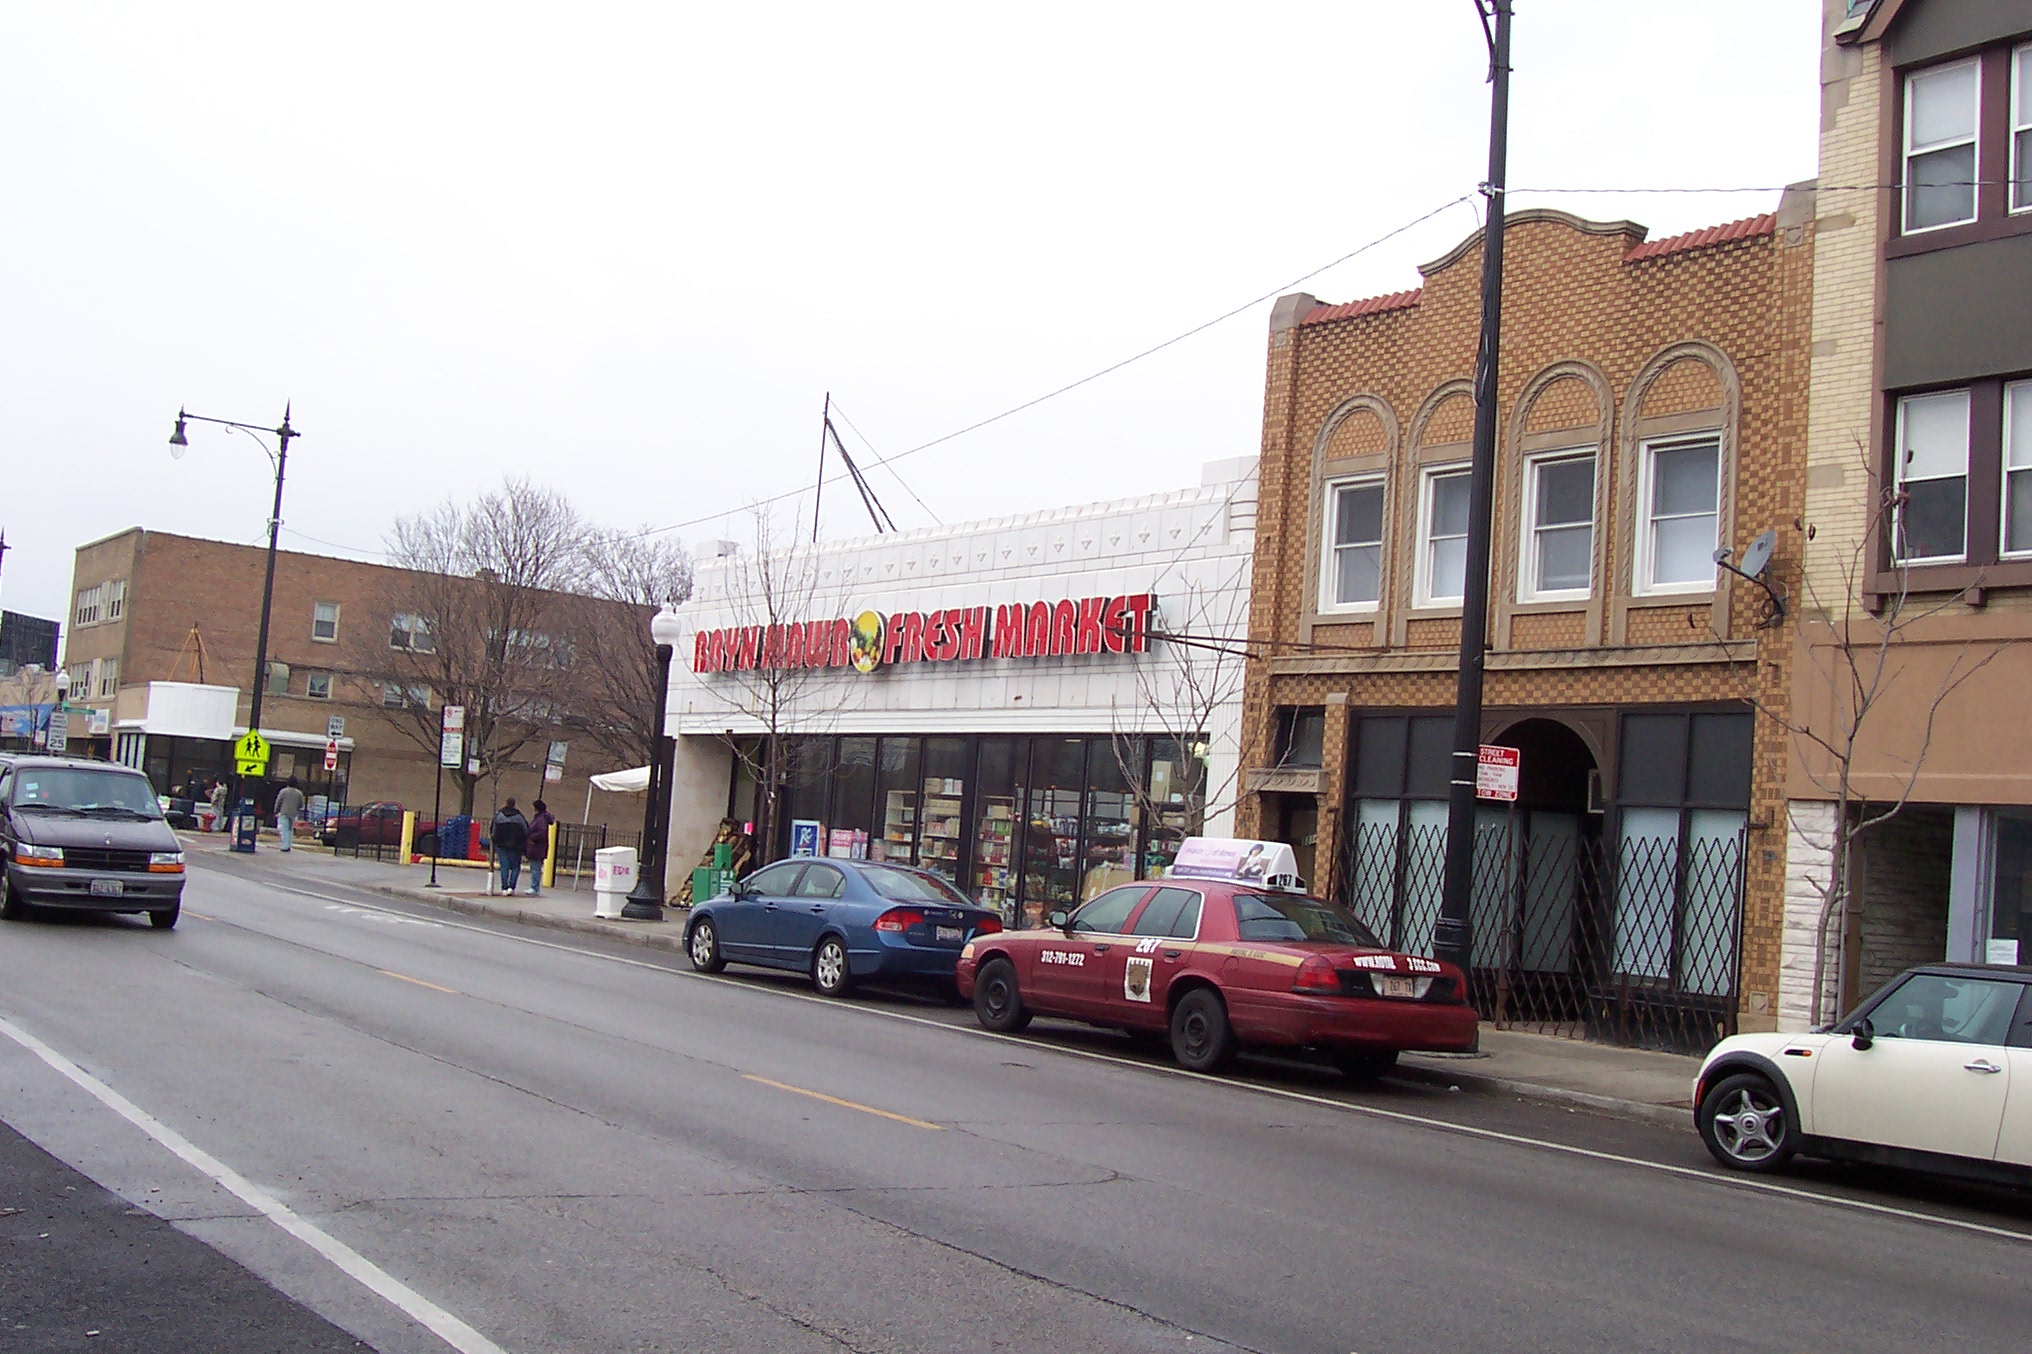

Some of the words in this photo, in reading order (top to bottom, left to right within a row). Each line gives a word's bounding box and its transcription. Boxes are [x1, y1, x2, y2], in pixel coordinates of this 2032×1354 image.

[693, 627, 762, 674] BRYN
[761, 617, 850, 670] MAWR
[884, 605, 991, 664] FRESH
[992, 593, 1155, 658] MARKET
[50, 738, 64, 748] 25
[1480, 748, 1505, 757] STREET
[1479, 756, 1514, 765] CLEANING
[1278, 873, 1292, 886] 267
[1136, 938, 1163, 953] 267
